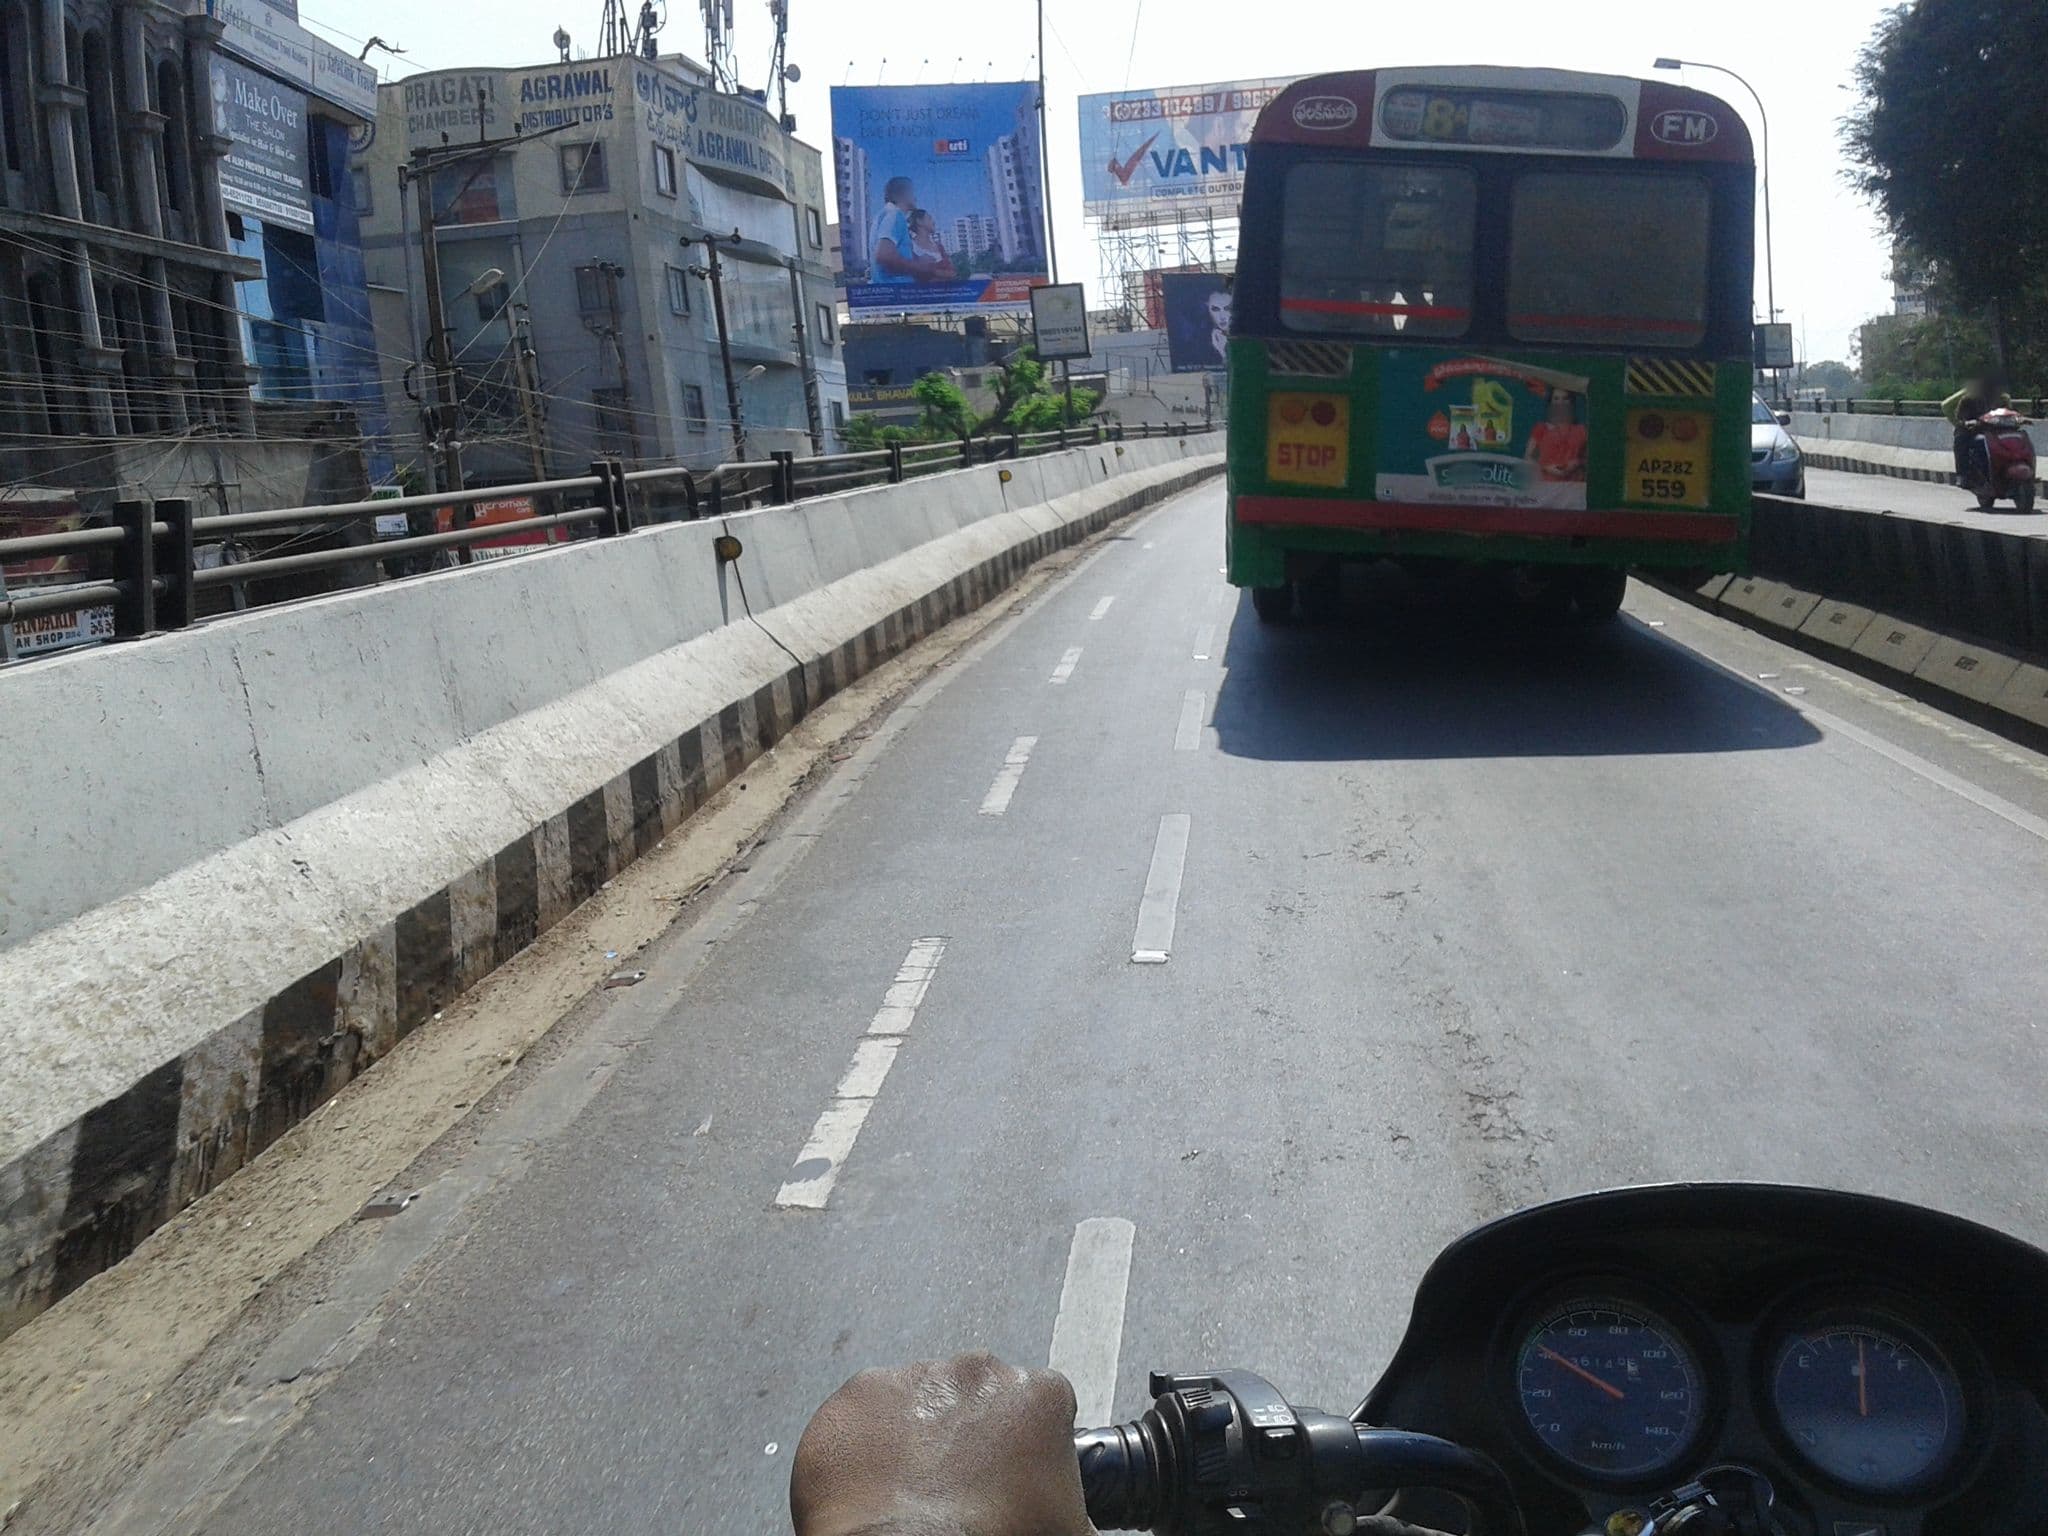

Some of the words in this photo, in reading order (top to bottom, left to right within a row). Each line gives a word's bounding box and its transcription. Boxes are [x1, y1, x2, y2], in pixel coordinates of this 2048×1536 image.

[404, 75, 495, 112] PRAGATI
[520, 69, 614, 104] AGRAWAL
[235, 78, 268, 116] Make
[270, 95, 298, 129] Over
[408, 106, 496, 133] CHAMBERS
[521, 103, 614, 129] DISTRIBUTORS
[1662, 114, 1707, 140] FM
[697, 129, 758, 171] AGRAWAL
[948, 139, 968, 152] uti
[1277, 443, 1337, 471] STOP
[1637, 458, 1694, 475] AP28Z
[1641, 479, 1687, 498] 559
[36, 631, 63, 647] SHOP
[1642, 1349, 1667, 1359] 100
[1798, 1355, 1810, 1368] E
[1896, 1358, 1909, 1371] F
[1531, 1388, 1552, 1399] 20
[1591, 1440, 1626, 1451] km/h
